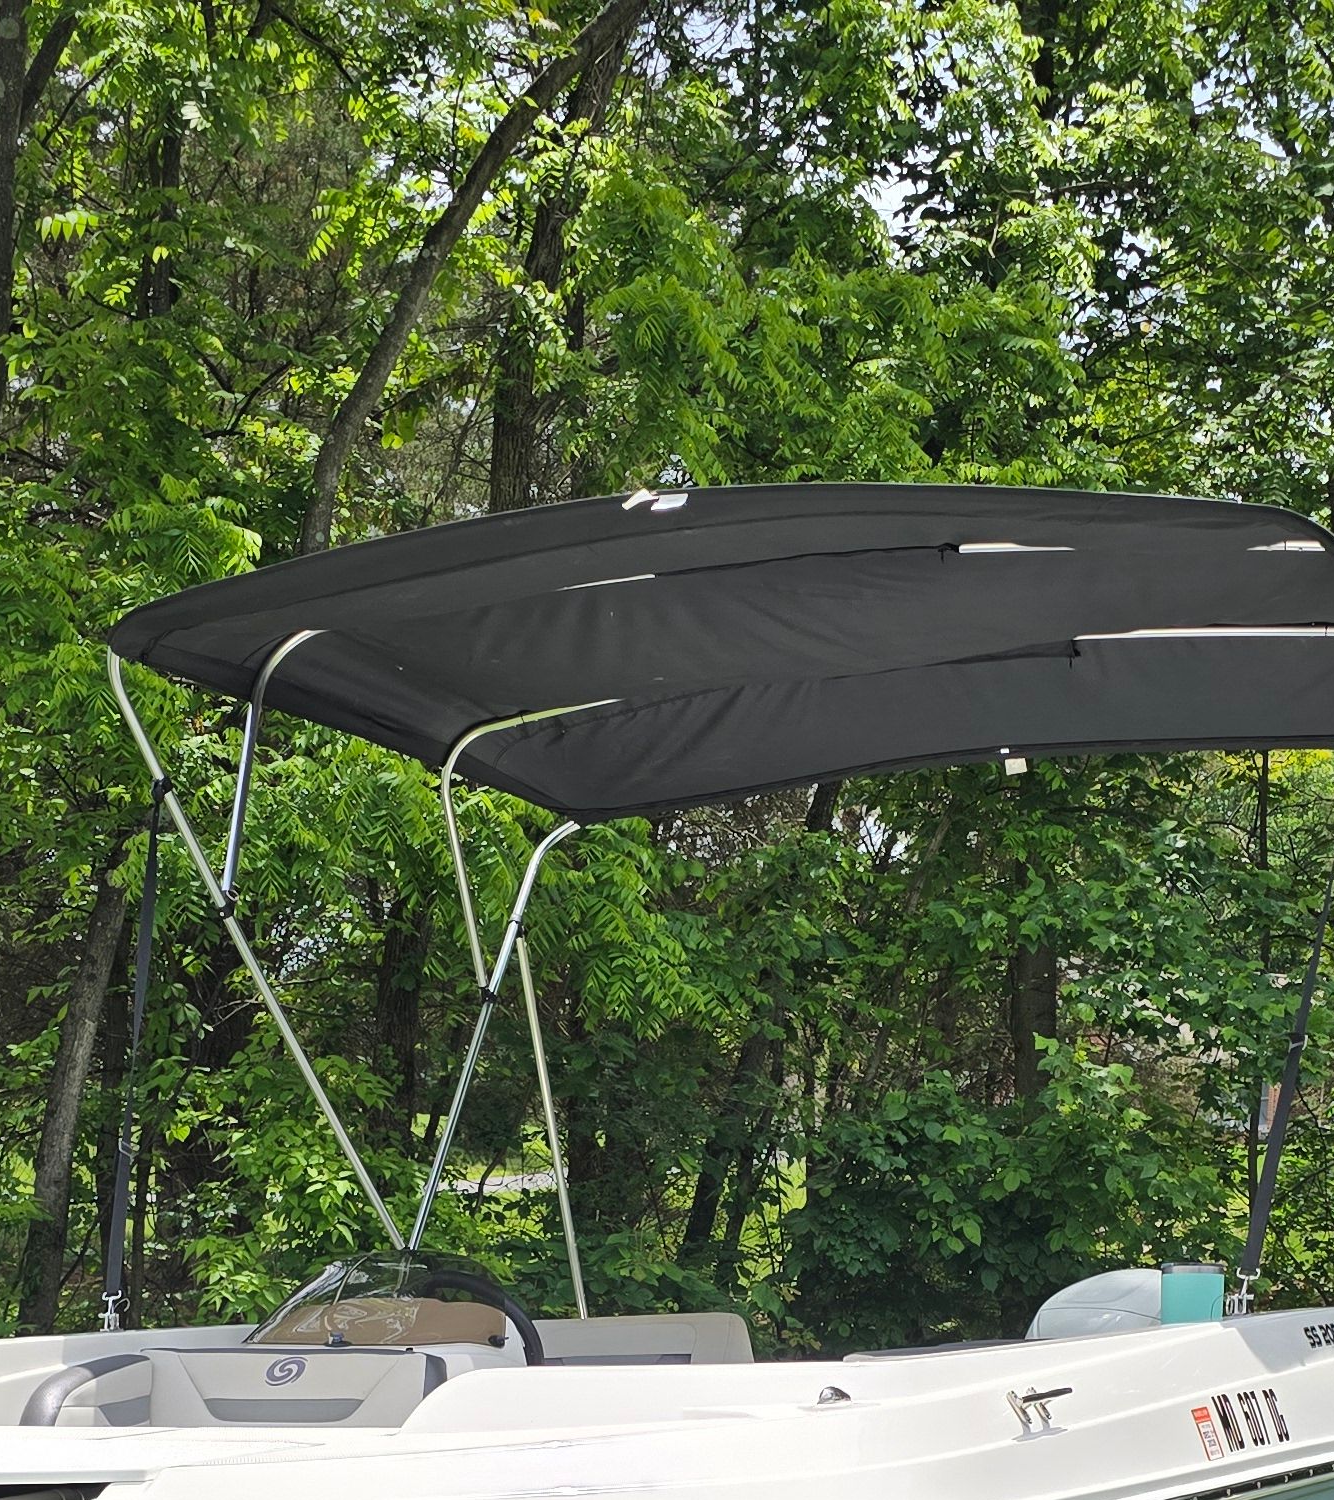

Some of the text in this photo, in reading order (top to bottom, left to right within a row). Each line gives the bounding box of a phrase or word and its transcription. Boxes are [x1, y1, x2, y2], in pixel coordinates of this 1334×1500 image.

[1303, 1325, 1322, 1349] SS
[1210, 1394, 1245, 1452] MD
[1237, 1391, 1271, 1446] 607
